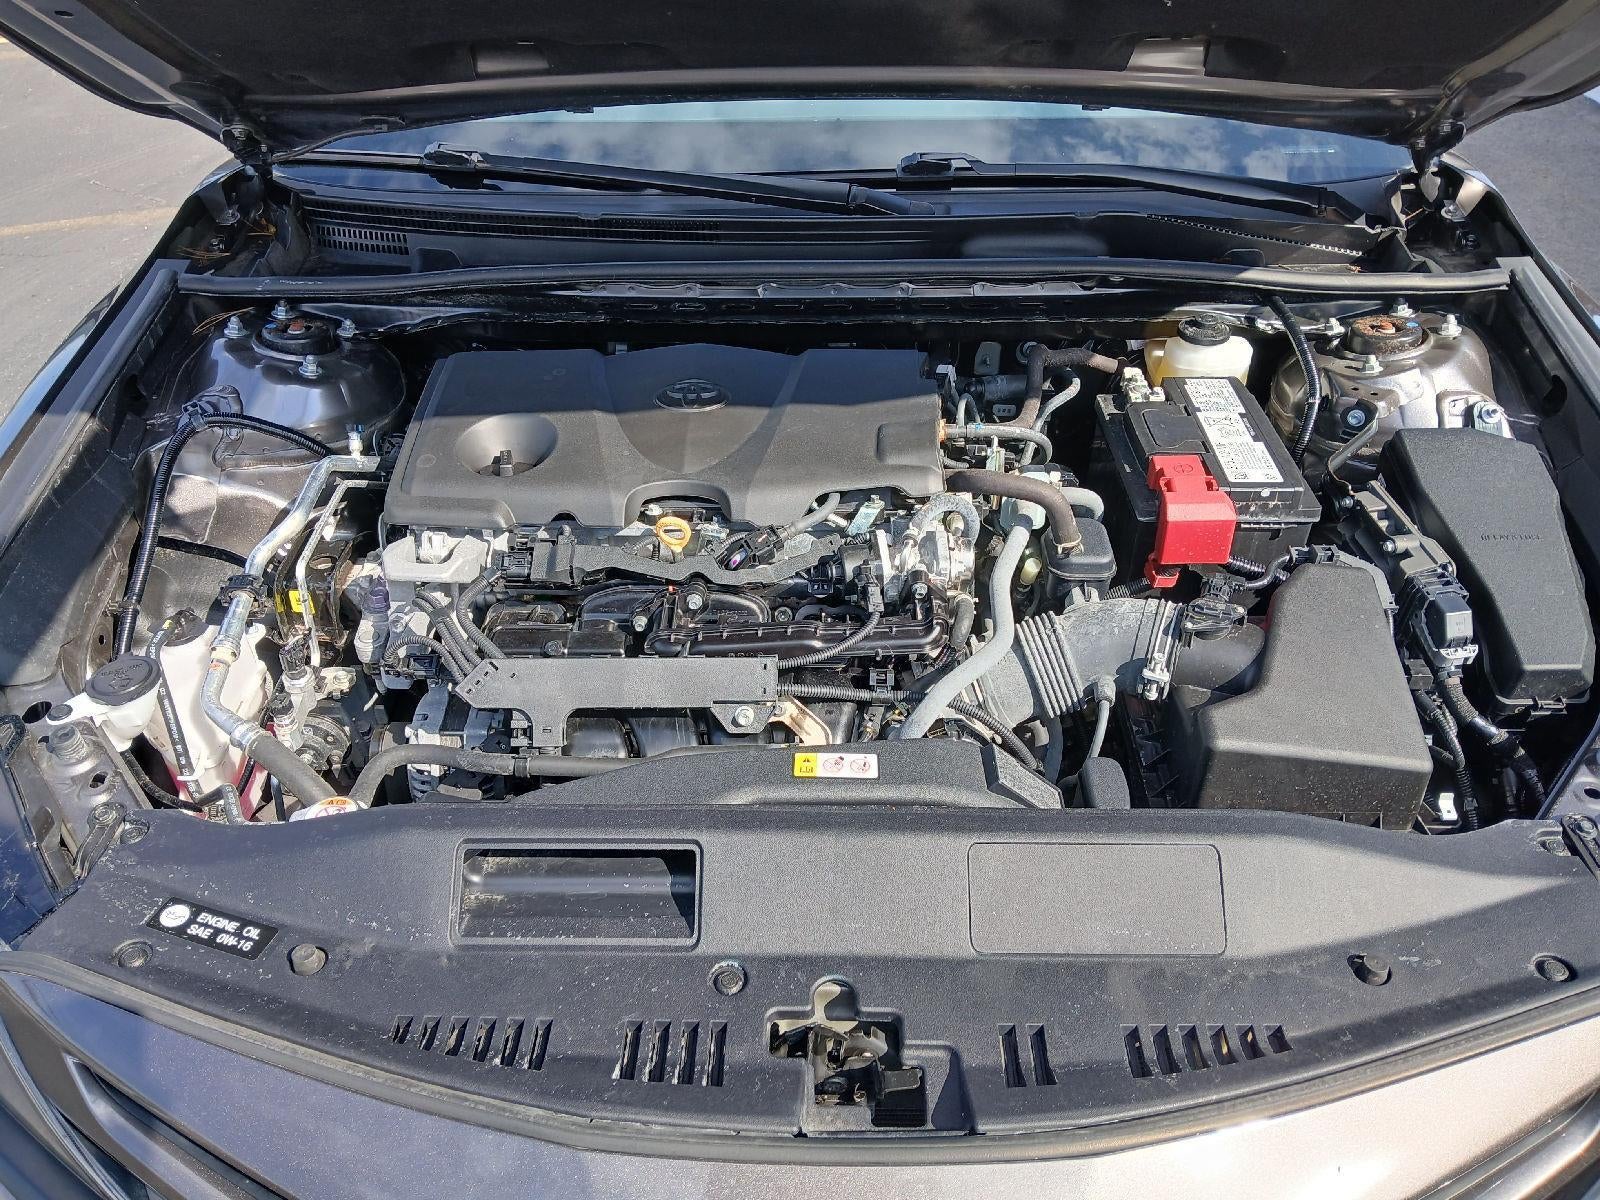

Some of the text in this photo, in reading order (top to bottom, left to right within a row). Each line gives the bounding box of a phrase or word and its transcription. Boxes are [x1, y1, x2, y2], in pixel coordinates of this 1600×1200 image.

[186, 924, 254, 952] SAE 0W-16
[196, 912, 261, 940] ENGINE OIL
